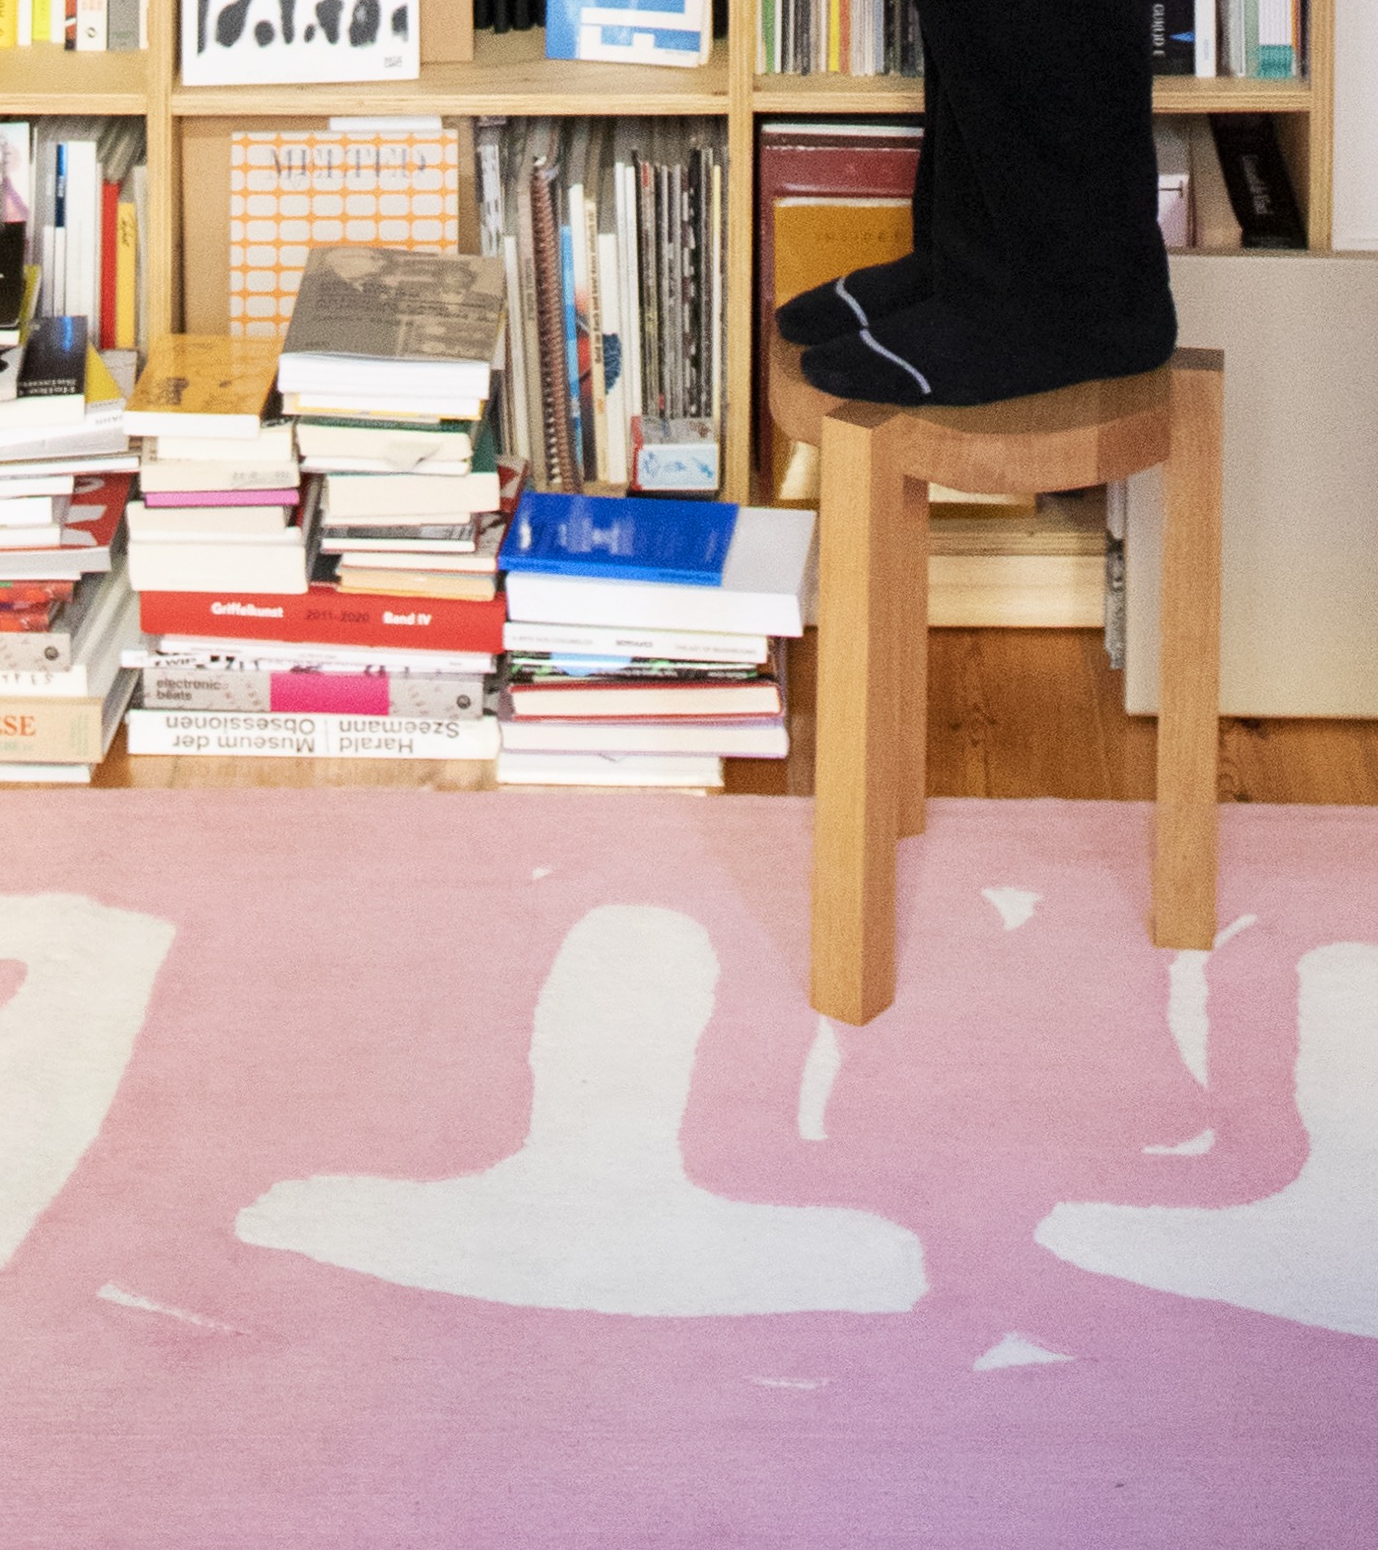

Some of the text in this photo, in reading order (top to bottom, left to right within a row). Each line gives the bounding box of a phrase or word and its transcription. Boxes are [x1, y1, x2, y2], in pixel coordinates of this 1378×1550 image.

[165, 716, 316, 736] Obsessionen
[339, 719, 460, 739] Szeemann
[173, 735, 316, 753] Museum der
[339, 736, 414, 754] Harald
